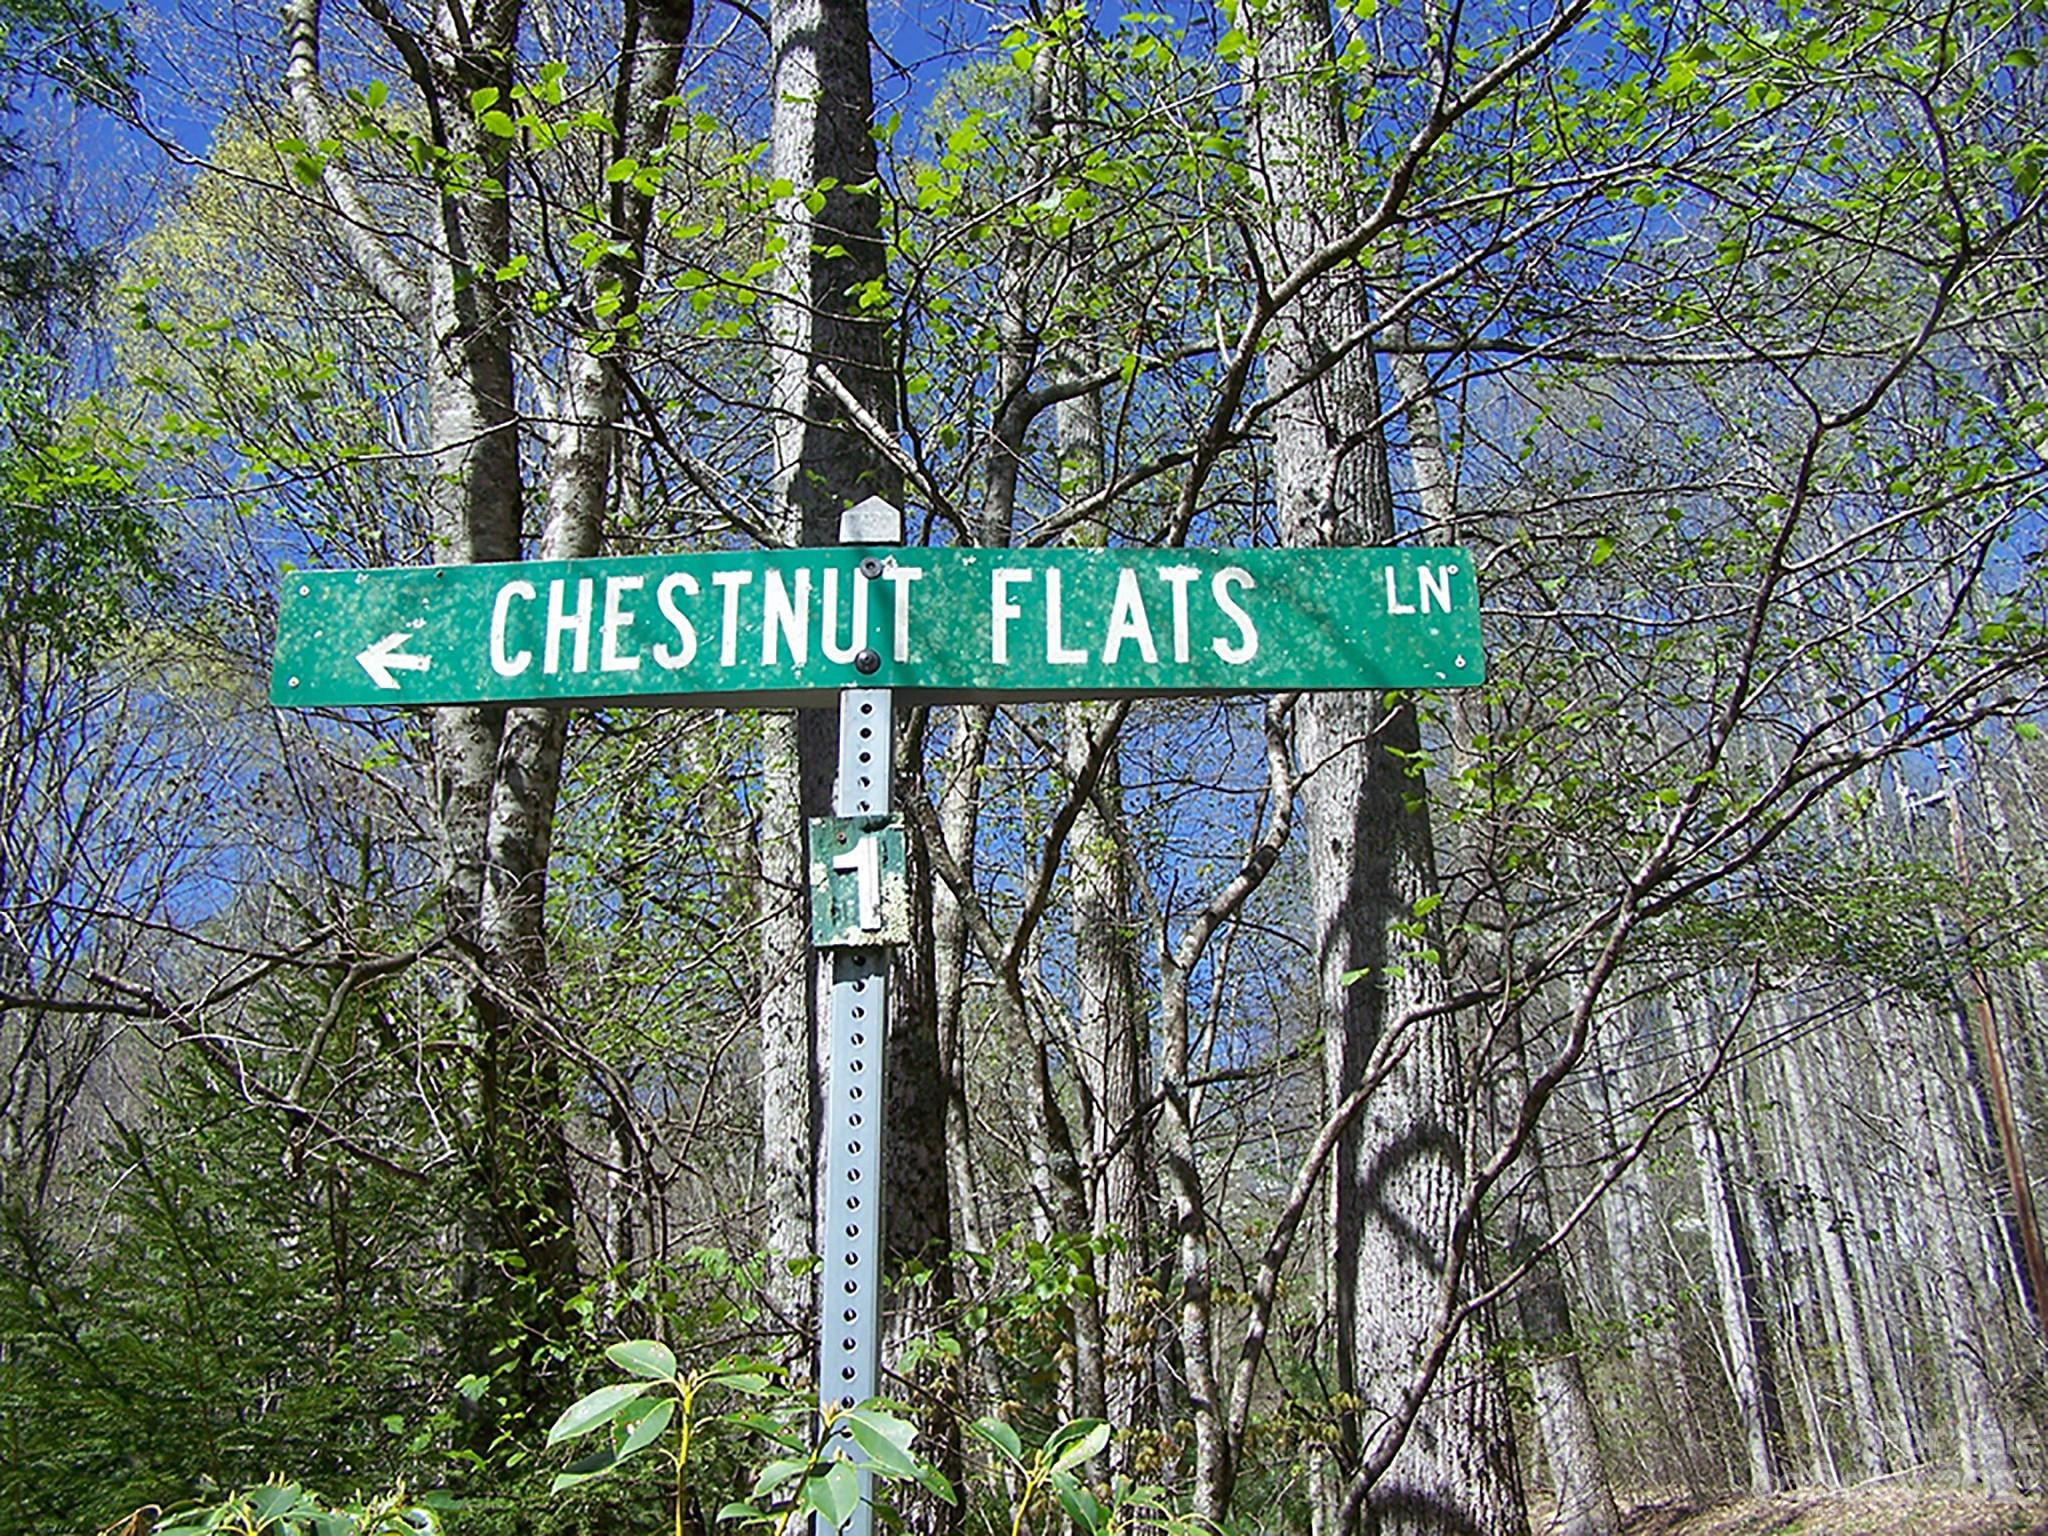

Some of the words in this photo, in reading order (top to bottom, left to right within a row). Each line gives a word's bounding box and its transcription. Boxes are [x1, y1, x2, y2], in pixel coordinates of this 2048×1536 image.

[490, 566, 923, 677] CHESTNUT
[991, 565, 1258, 665] FLATS
[1385, 564, 1453, 615] LN
[832, 836, 881, 930] 1
